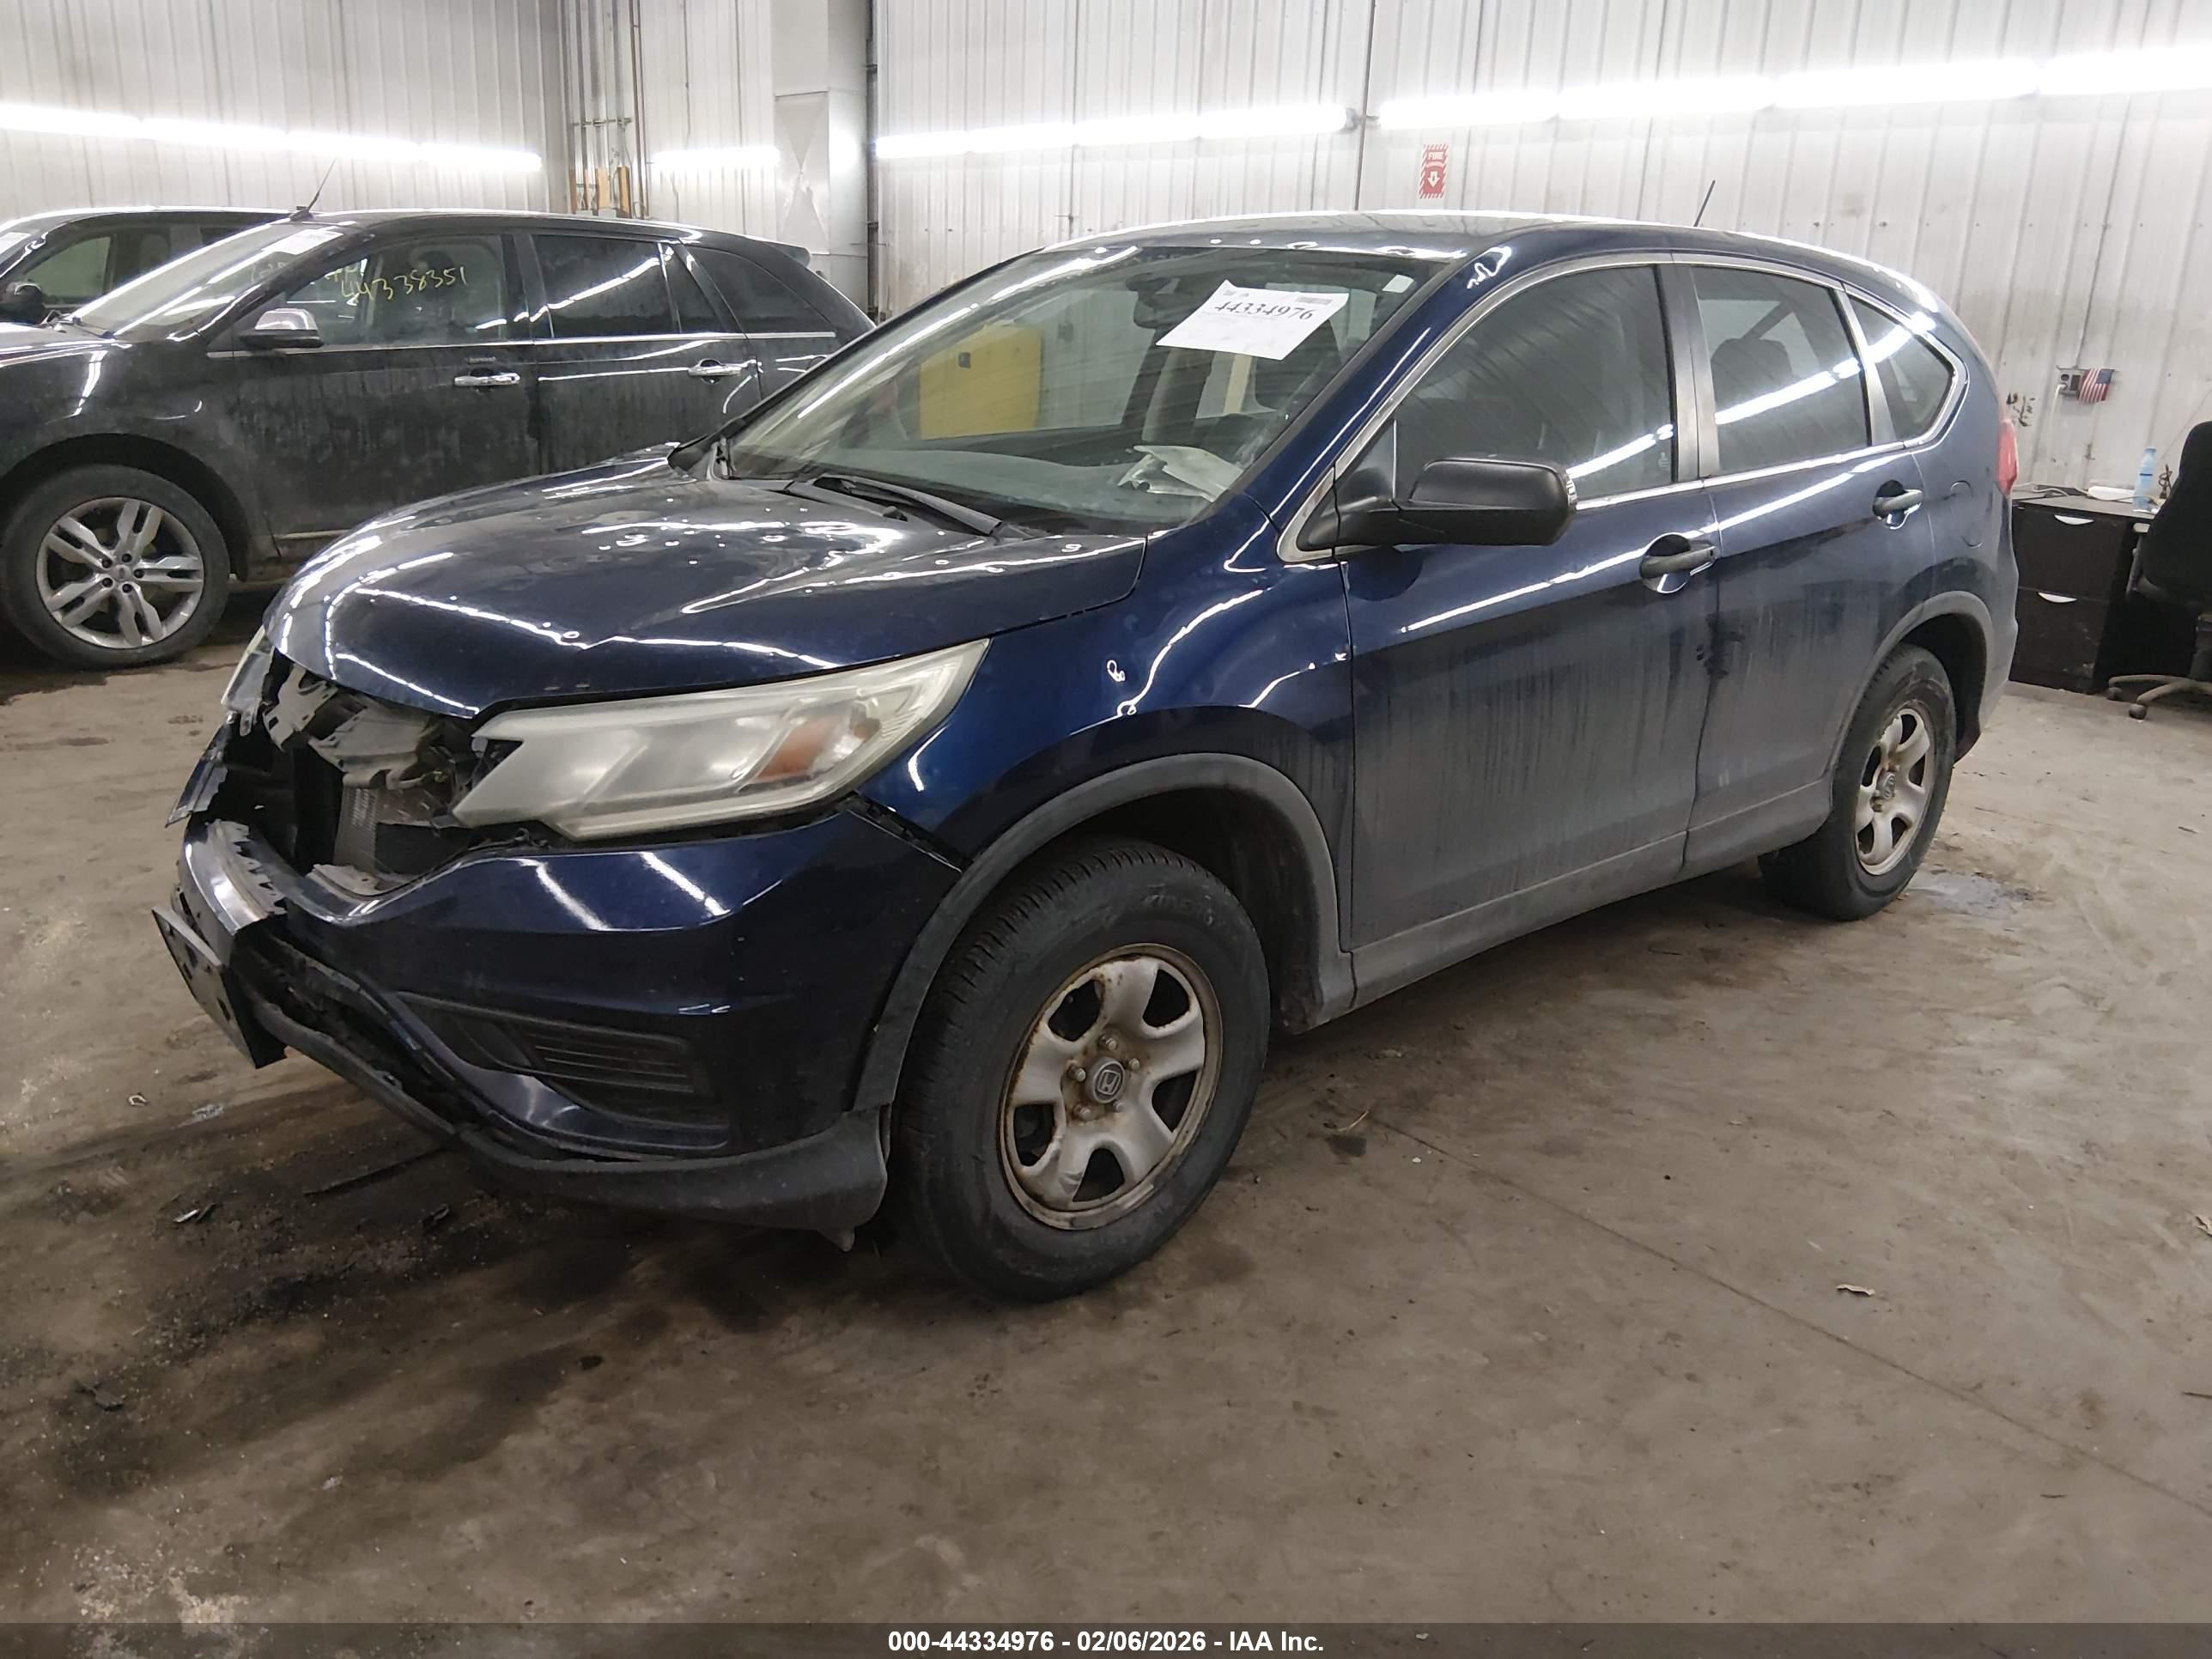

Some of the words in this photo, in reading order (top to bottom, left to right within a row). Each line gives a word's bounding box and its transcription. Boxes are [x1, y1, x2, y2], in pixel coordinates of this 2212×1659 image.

[1428, 151, 1444, 161] FIRE
[342, 266, 468, 301] 44338351
[1214, 301, 1316, 321] 44334976
